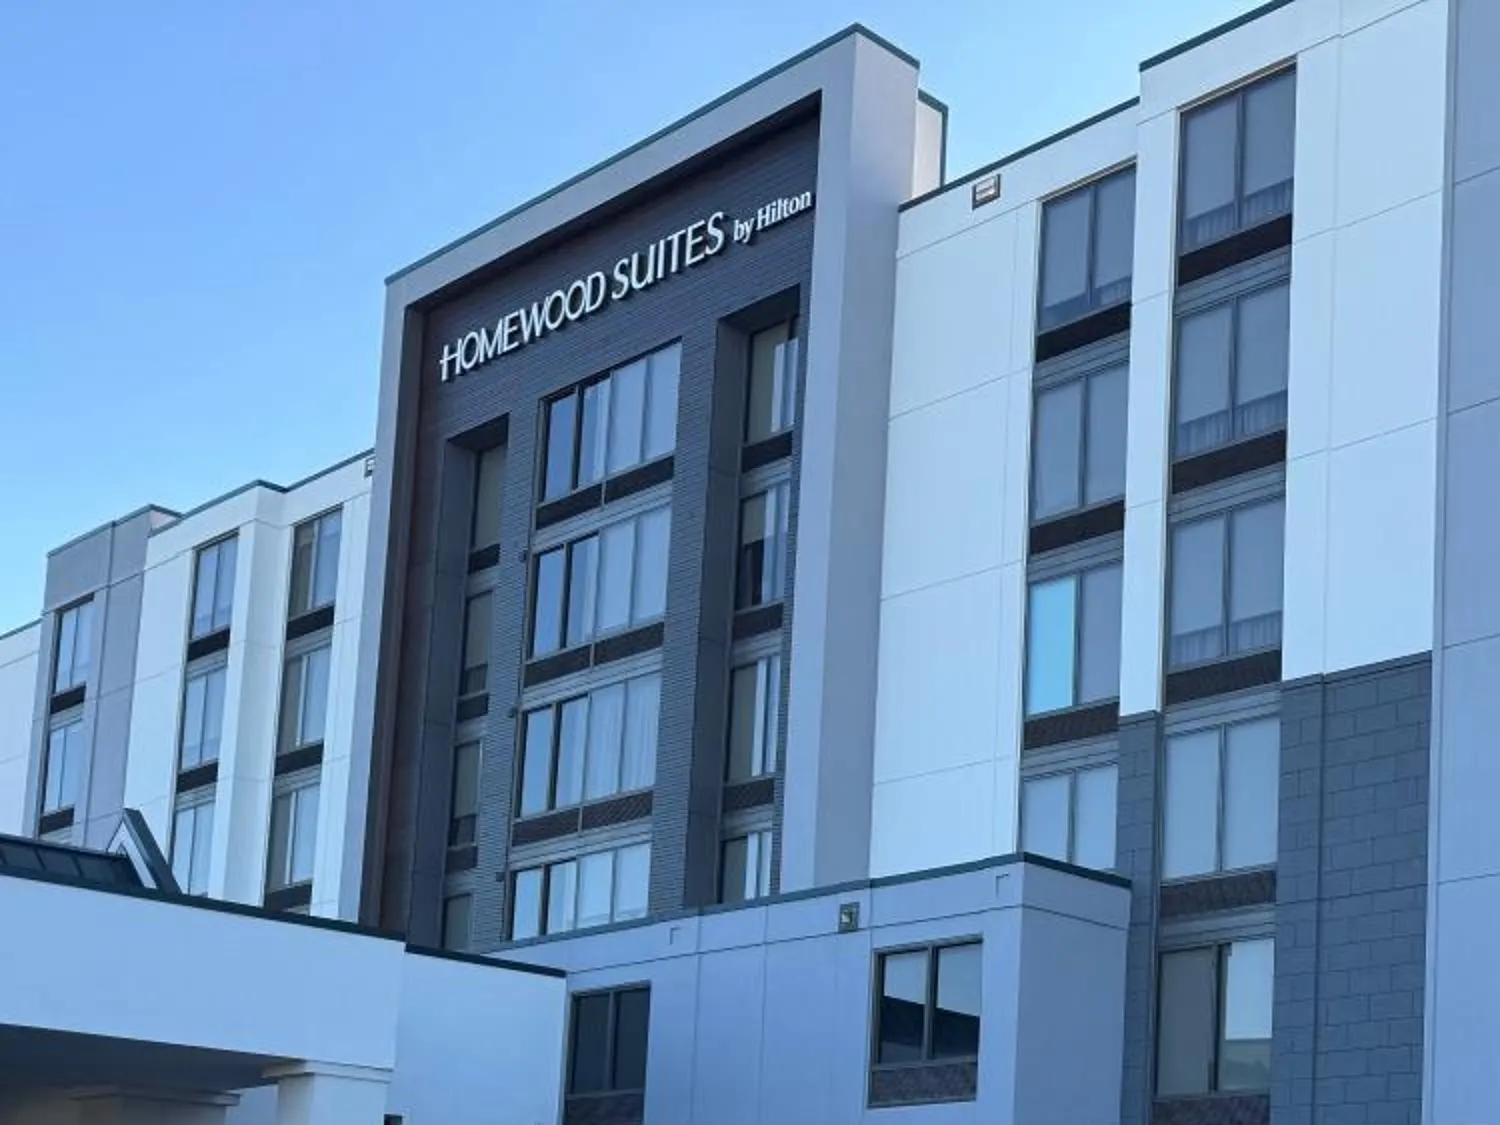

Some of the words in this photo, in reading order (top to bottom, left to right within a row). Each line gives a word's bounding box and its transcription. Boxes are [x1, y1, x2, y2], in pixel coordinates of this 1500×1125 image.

[439, 270, 607, 382] HOMEWOOD
[611, 211, 725, 300] SUITES
[733, 218, 755, 245] by
[756, 190, 812, 232] Hilton
